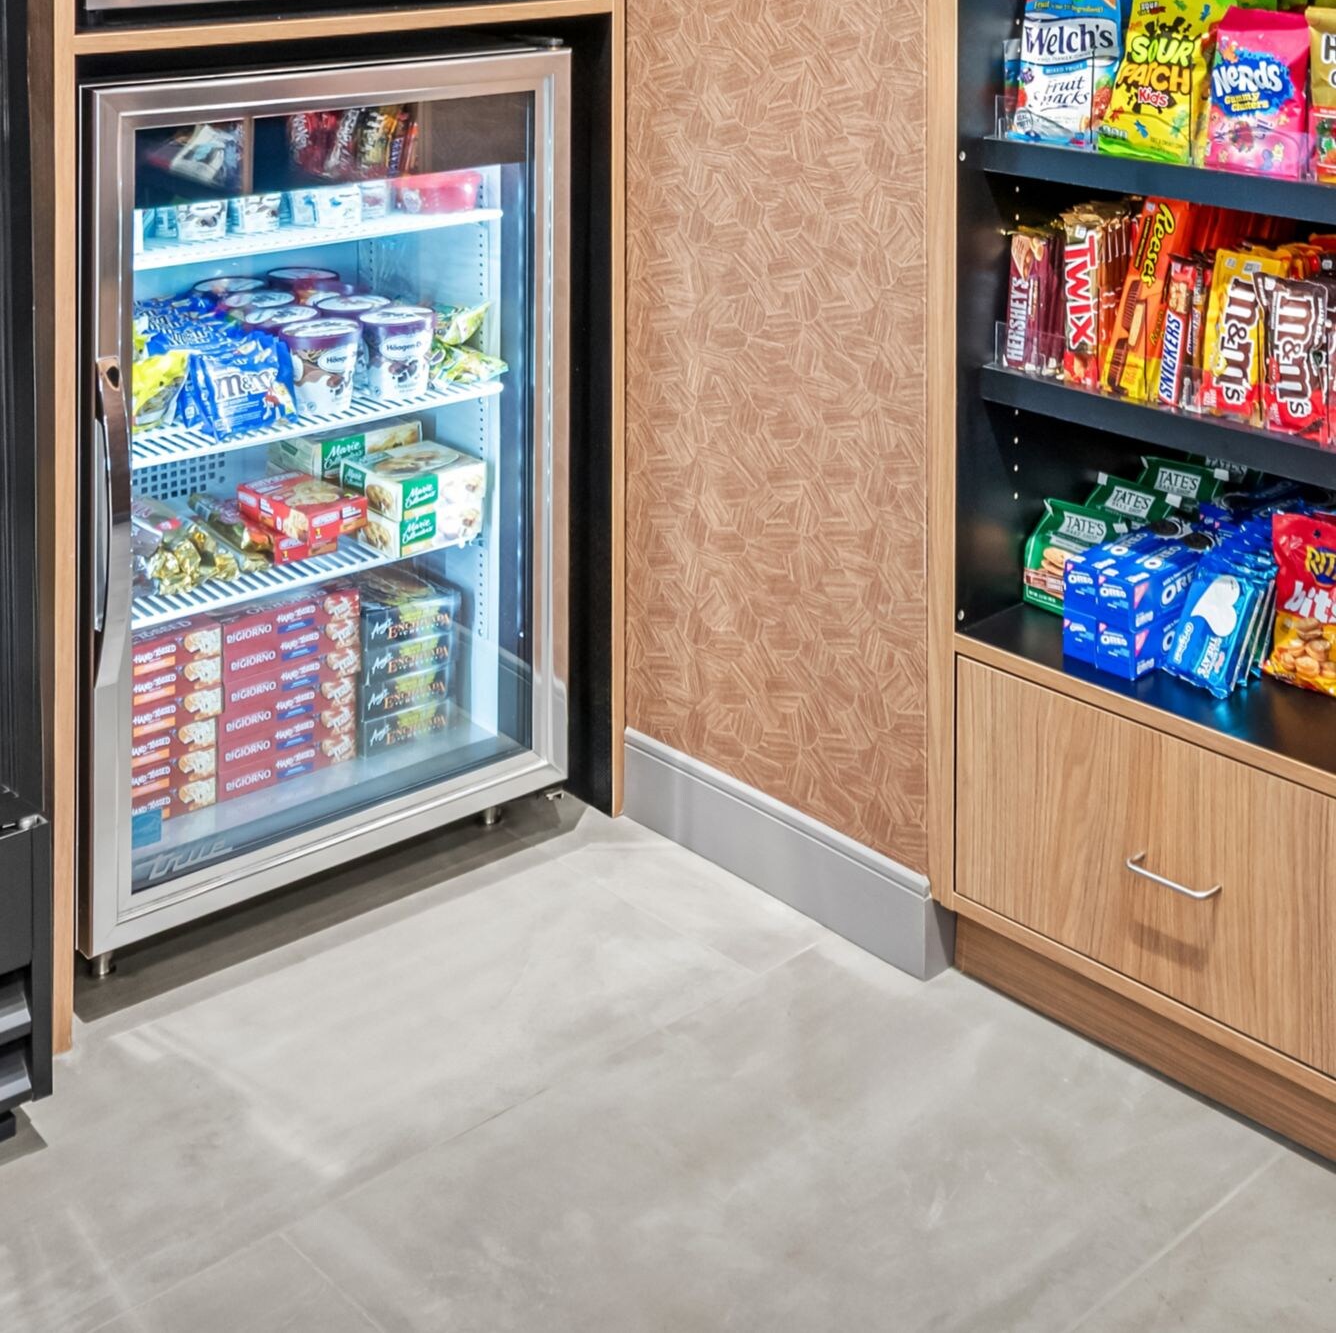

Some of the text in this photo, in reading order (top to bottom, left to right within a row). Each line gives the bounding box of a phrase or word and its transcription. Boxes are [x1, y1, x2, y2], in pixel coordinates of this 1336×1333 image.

[1025, 23, 1114, 57] Welch's
[1132, 35, 1195, 68] SOUR
[1046, 75, 1086, 95] Fruit
[1117, 62, 1191, 95] PATCH
[1137, 87, 1169, 108] Kids
[1142, 203, 1176, 288] Reese's
[1064, 234, 1097, 348] TWIX
[1007, 276, 1029, 362] HERSHEY'S
[1159, 315, 1181, 399] SNICKERS
[330, 441, 360, 456] Marie
[411, 483, 433, 497] Marie
[1159, 469, 1199, 492] TATE'S
[1114, 488, 1151, 511] TATE'S
[408, 519, 431, 533] Marie
[1065, 515, 1105, 537] TATE'S
[1067, 573, 1094, 585] OREO
[1100, 586, 1127, 598] OREO
[1100, 634, 1128, 647] OREO
